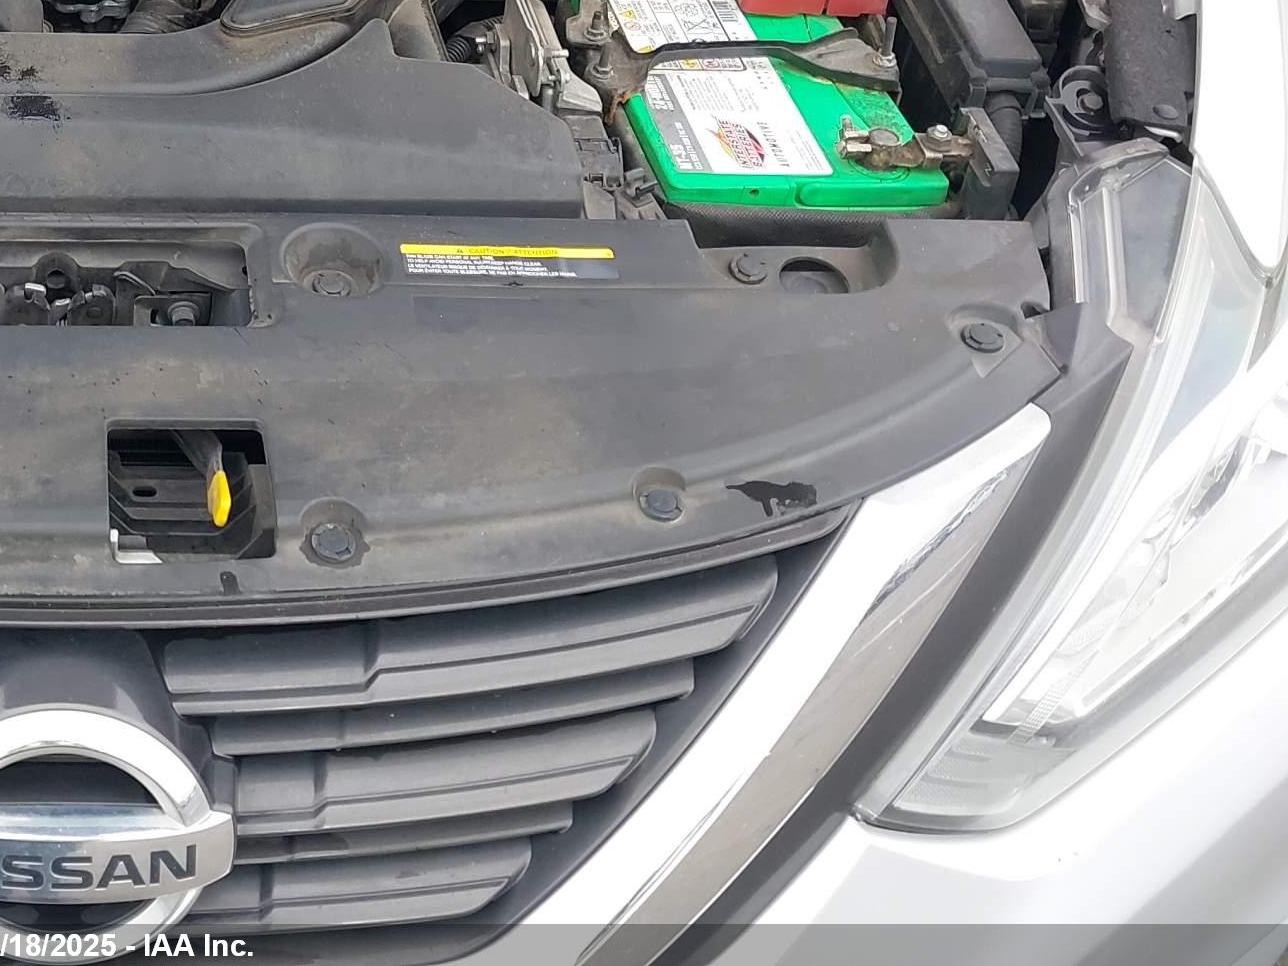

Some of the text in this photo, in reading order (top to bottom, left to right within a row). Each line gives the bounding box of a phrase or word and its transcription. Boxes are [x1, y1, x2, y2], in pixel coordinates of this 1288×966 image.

[718, 120, 753, 169] INTERSTATE
[732, 123, 763, 167] BATTERIES
[757, 121, 791, 167] AUTOMOTIVE
